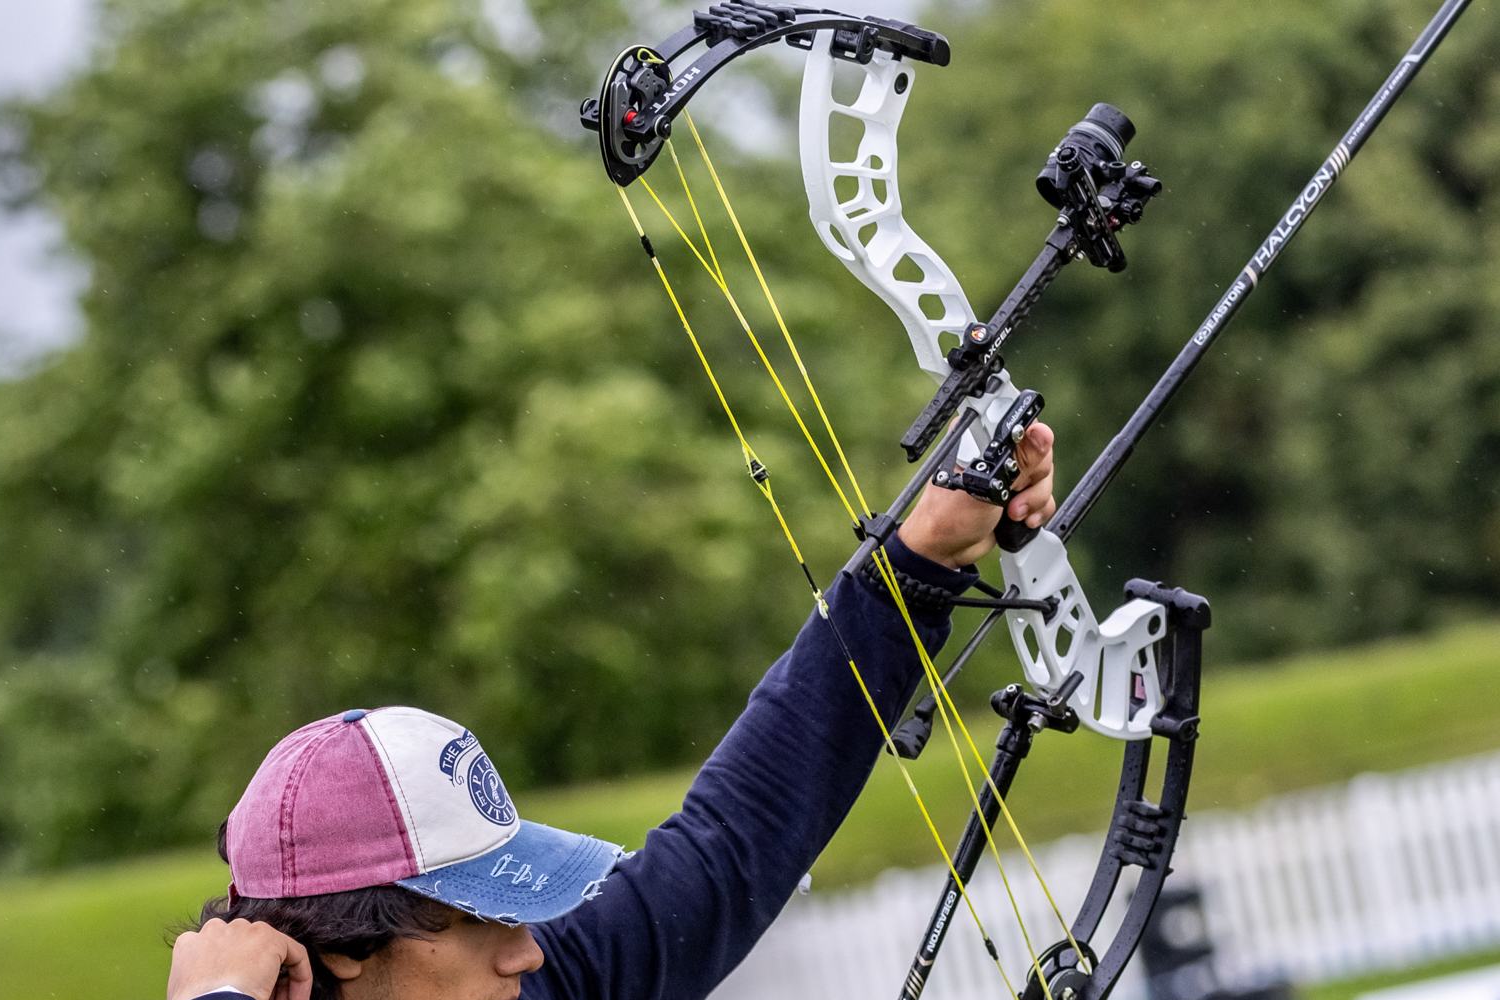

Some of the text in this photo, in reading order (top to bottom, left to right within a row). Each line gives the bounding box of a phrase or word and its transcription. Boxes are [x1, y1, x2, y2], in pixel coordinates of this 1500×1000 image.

[652, 66, 701, 113] HOYT
[1254, 167, 1332, 268] HALCYON
[1208, 280, 1246, 328] EASTON
[983, 326, 1012, 364] AXCEL
[442, 745, 459, 770] THE
[927, 904, 954, 953] EASTON
